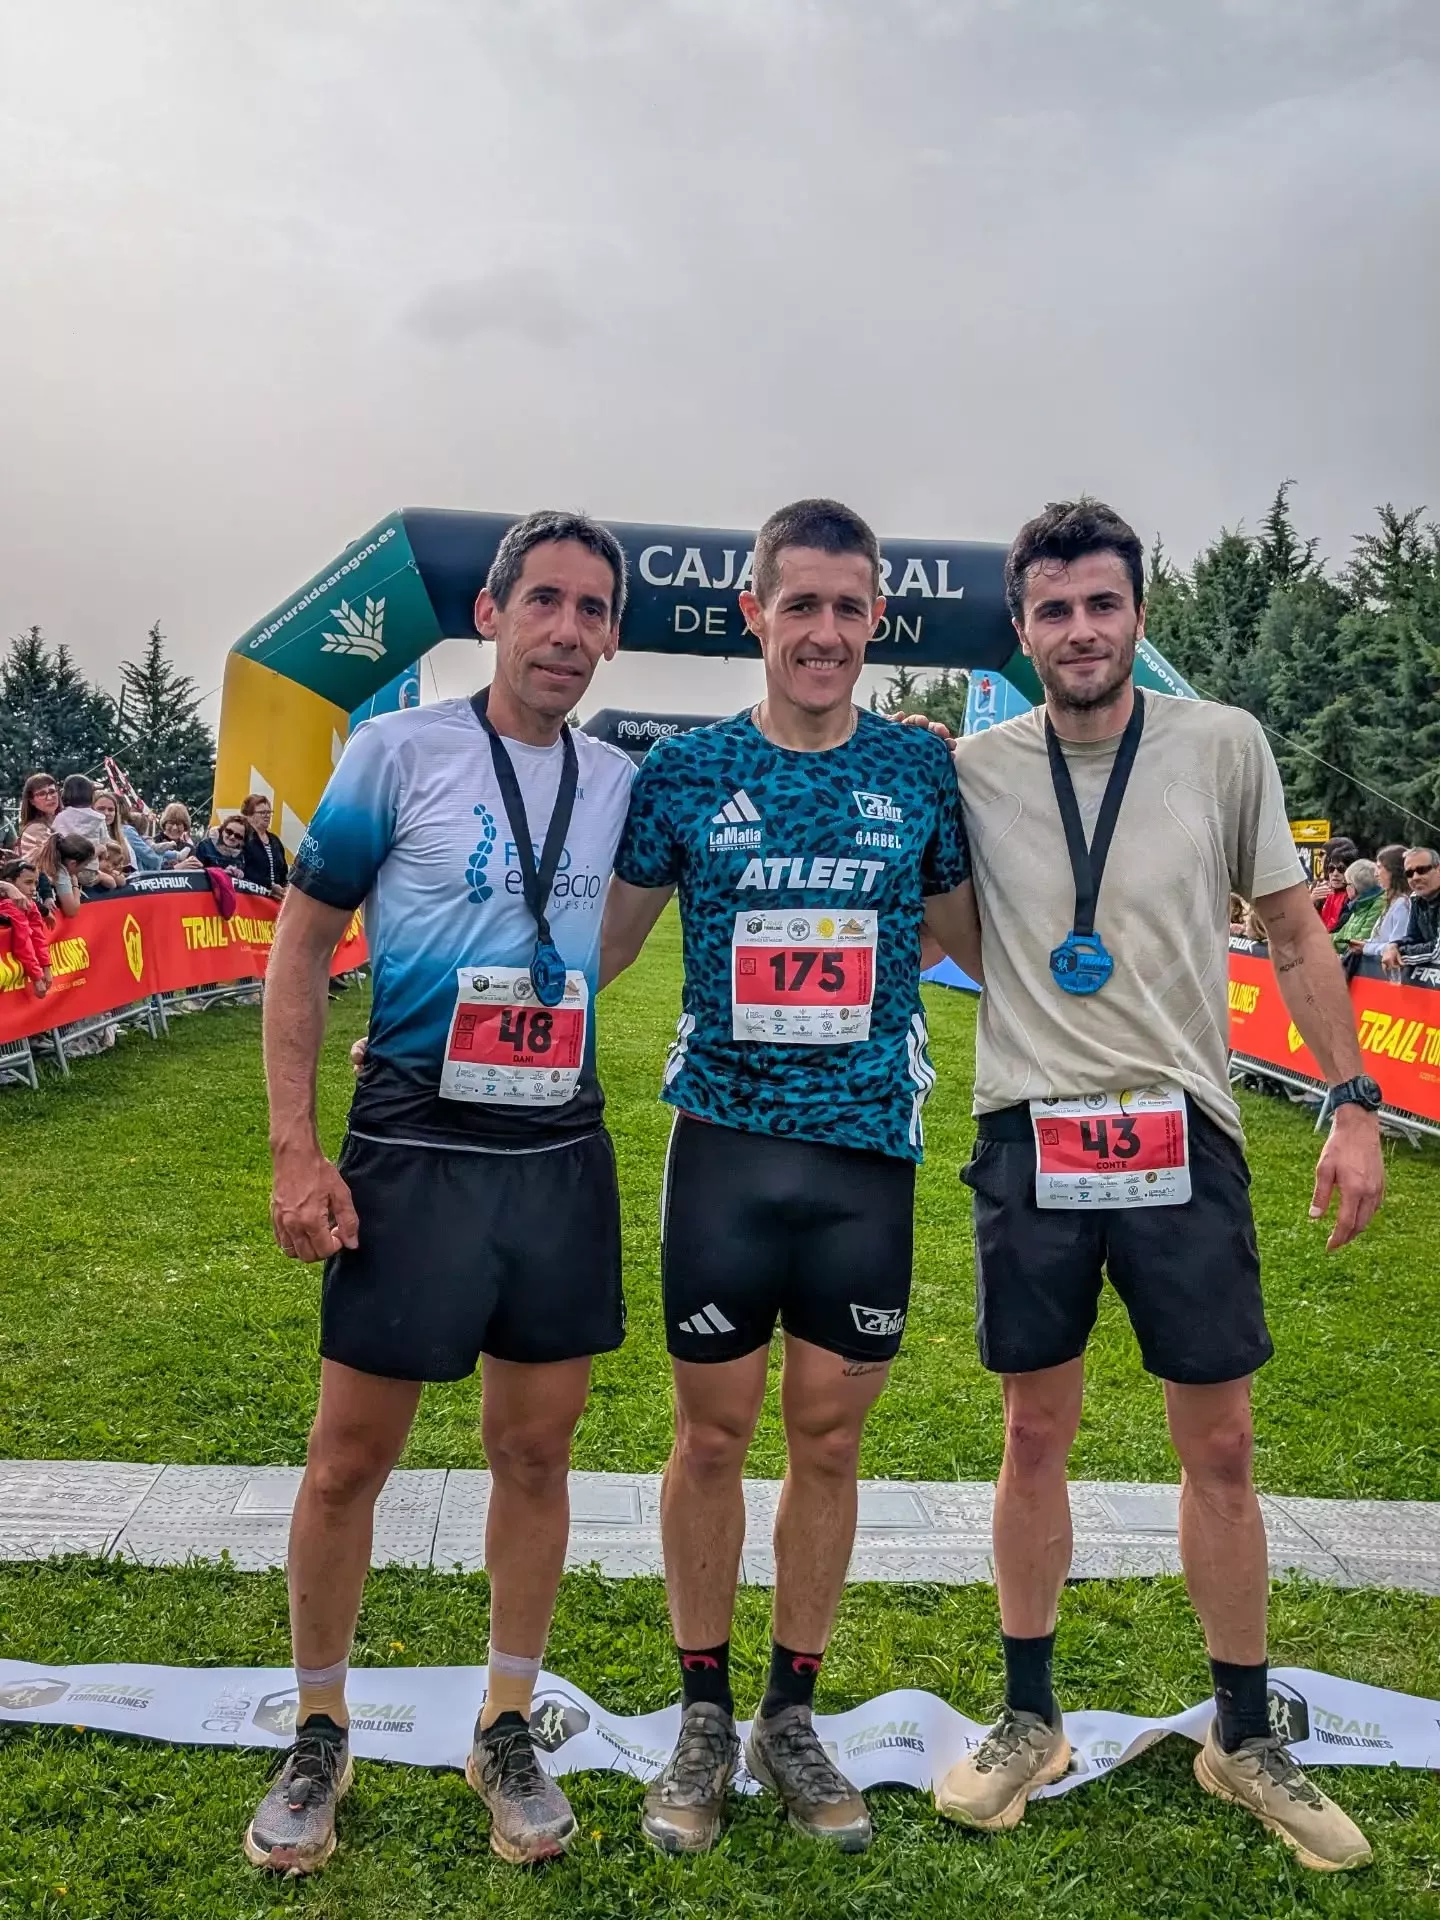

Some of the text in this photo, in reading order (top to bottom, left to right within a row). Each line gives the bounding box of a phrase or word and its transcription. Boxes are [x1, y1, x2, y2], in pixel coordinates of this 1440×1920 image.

[250, 527, 396, 648] cajaruraldearagon.es
[879, 558, 964, 599] RAL
[675, 605, 727, 634] DE
[855, 831, 902, 849] GARBEL
[131, 877, 193, 891] FIREHAWK
[505, 865, 601, 899] eacio
[735, 857, 885, 892] ATLEET
[553, 901, 595, 911] UESCA
[182, 916, 228, 950] TRAIL
[769, 951, 846, 993] 175
[499, 1010, 553, 1053] 48
[1358, 1010, 1424, 1064] TRAIL
[513, 1055, 534, 1063] DANI
[1080, 1117, 1141, 1159] 43
[1096, 1161, 1128, 1169] CONTE
[67, 1693, 150, 1710] TORROLLONES
[75, 1683, 155, 1699] TRAIL
[201, 1719, 241, 1732] ca
[350, 1719, 415, 1733] RROLLONES
[844, 1720, 923, 1748] TRAIL
[1313, 1706, 1388, 1738] TRAIL
[845, 1736, 925, 1760] TORROLLONES
[1313, 1727, 1394, 1750] TORROLLONES
